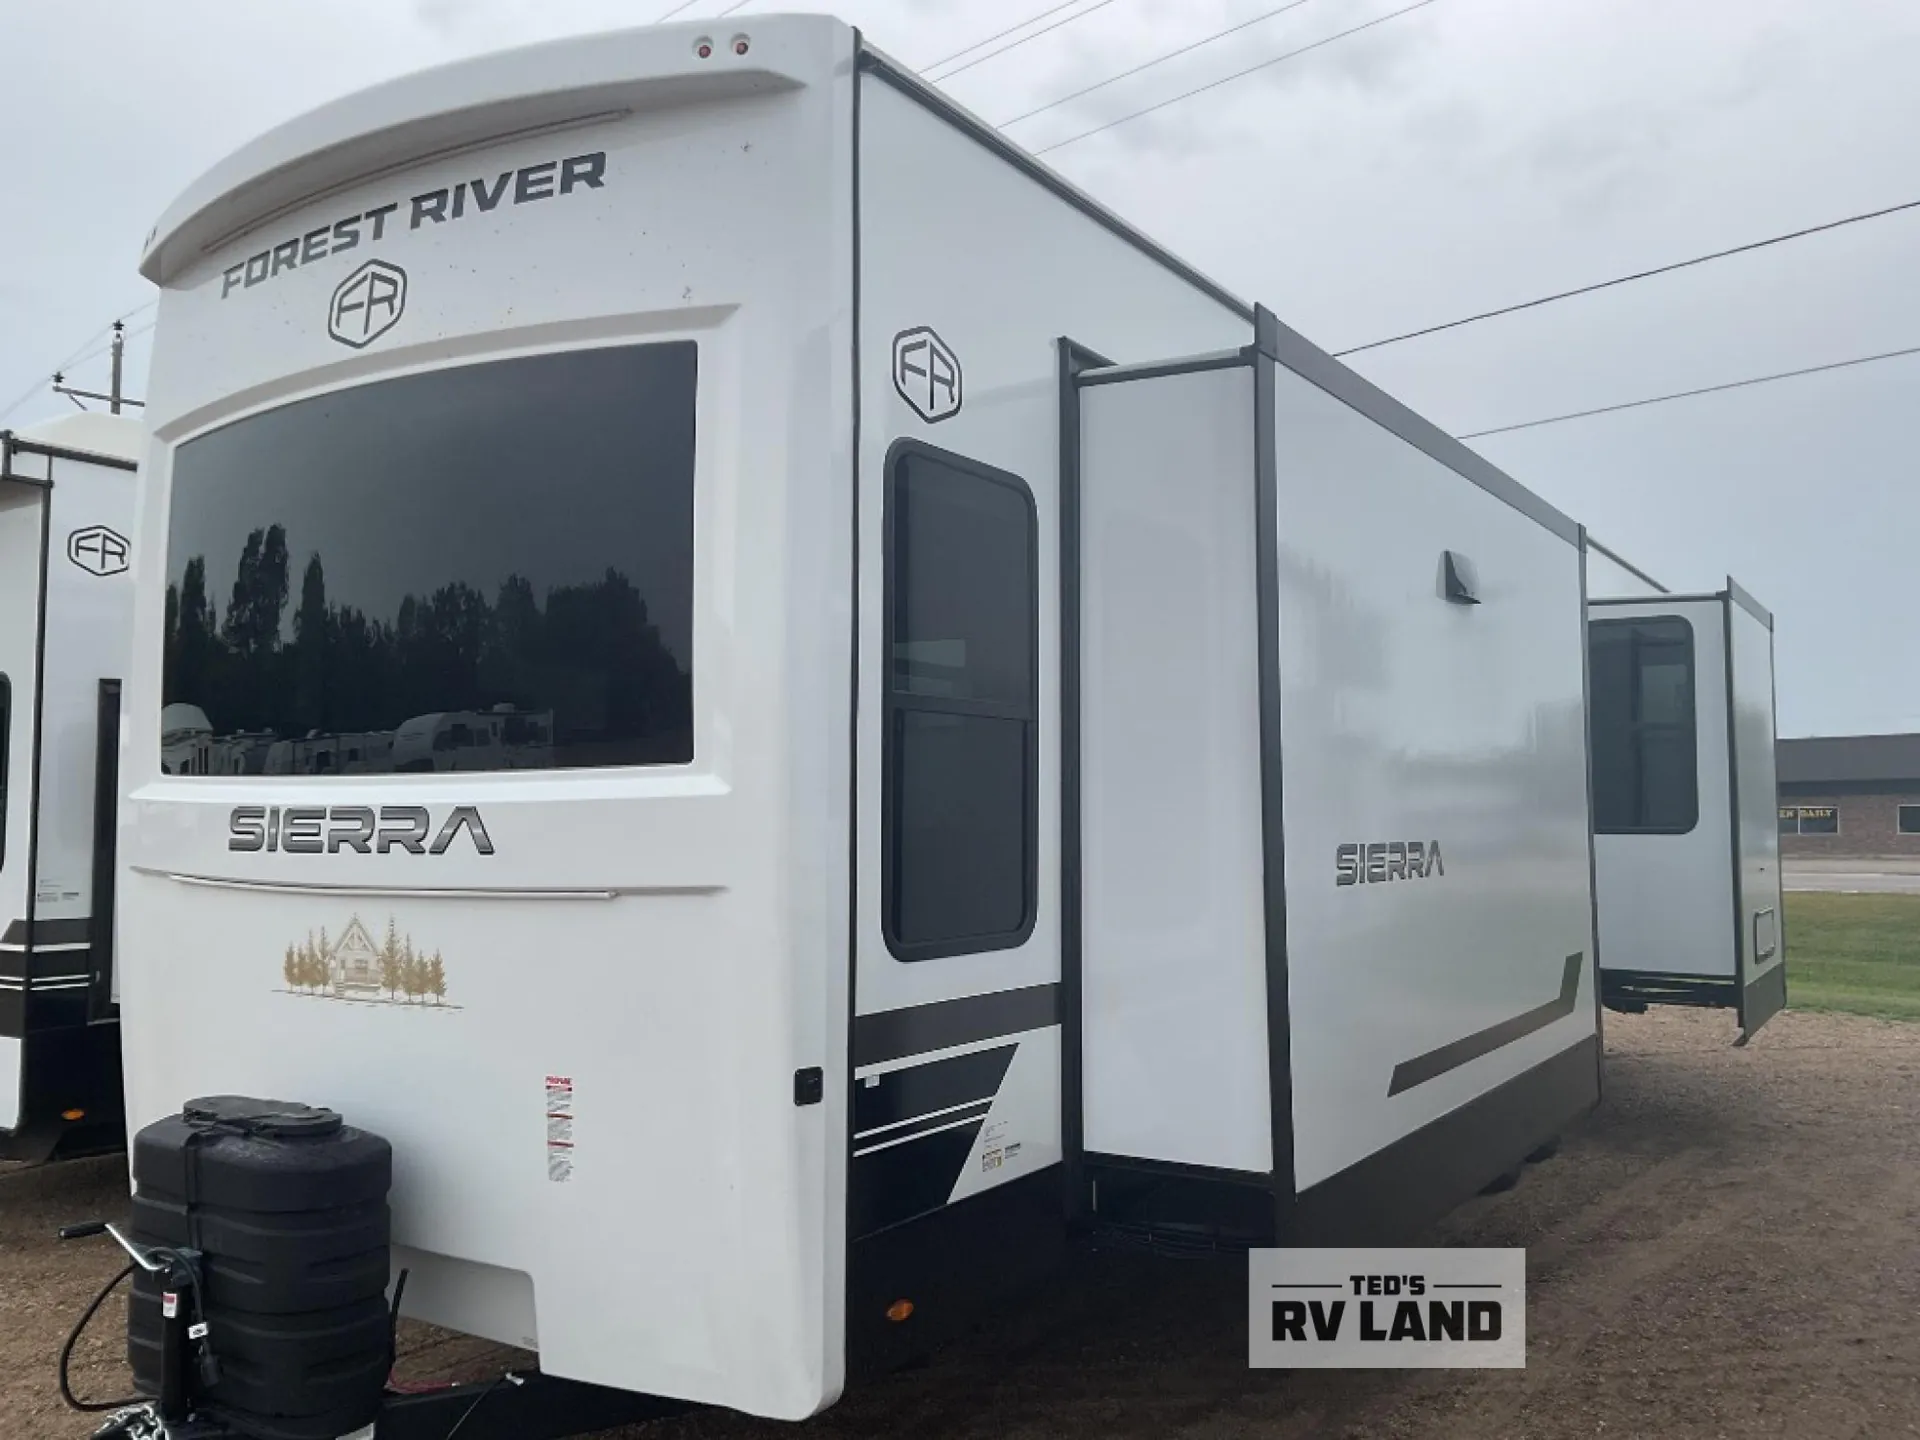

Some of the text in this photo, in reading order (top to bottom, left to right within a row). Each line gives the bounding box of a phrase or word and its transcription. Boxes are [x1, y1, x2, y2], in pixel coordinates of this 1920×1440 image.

[221, 152, 606, 300] FOREST RIVER
[228, 805, 495, 855] SIERRA
[1336, 840, 1445, 886] SIERRA
